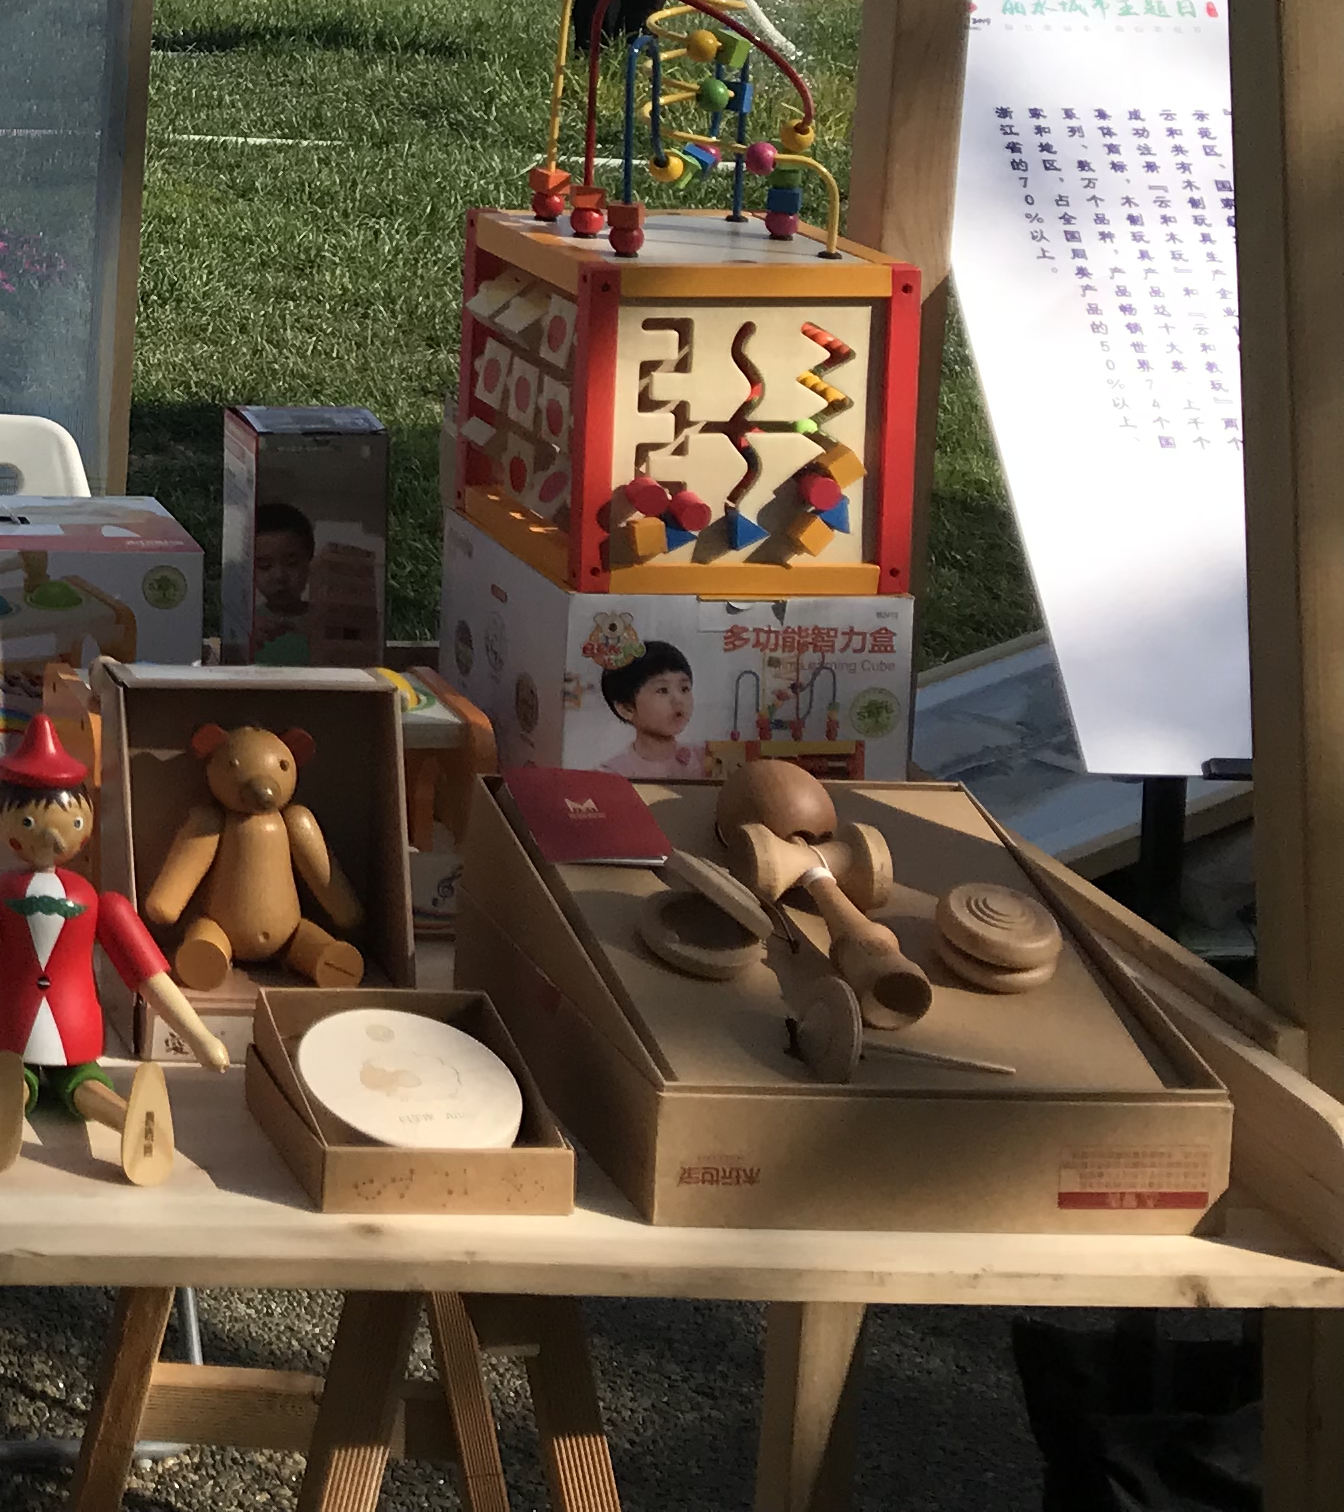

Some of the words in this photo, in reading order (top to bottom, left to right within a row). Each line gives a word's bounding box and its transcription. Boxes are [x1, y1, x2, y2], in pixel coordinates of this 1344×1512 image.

[723, 624, 897, 654] 多功能智力盒
[861, 660, 896, 672] Cube
